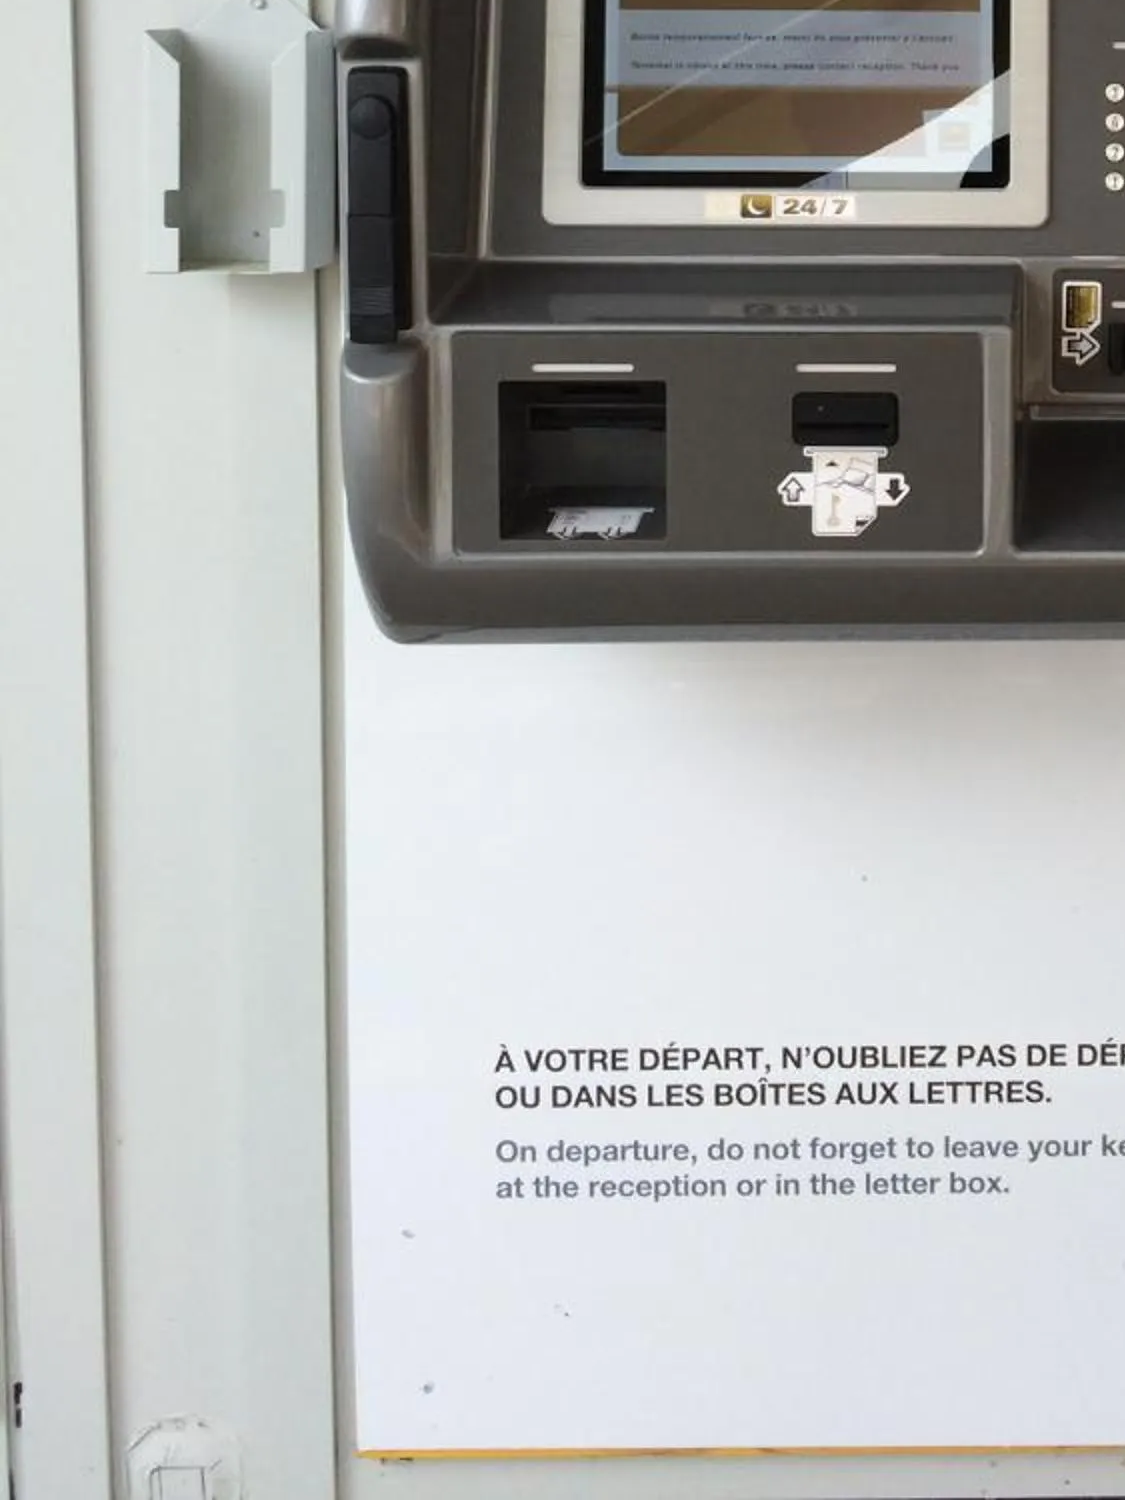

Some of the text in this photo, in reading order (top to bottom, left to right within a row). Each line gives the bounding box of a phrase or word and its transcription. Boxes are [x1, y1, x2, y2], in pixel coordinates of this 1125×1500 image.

[493, 1043, 517, 1074] À
[523, 1047, 630, 1074] VOTRE
[638, 1040, 772, 1075] DÉPART,
[956, 1043, 1018, 1069] PAS
[1025, 1043, 1068, 1068] DE
[494, 1076, 1053, 1110] OU DANS LES BOÎTES AUX LETTRES.
[495, 1139, 538, 1164] On
[545, 1139, 698, 1168] departure,
[706, 1136, 745, 1162] do
[753, 1137, 802, 1161] not
[807, 1136, 898, 1166] forget
[904, 1136, 935, 1160] to
[943, 1134, 1020, 1159] leave
[1026, 1139, 1094, 1164] your
[495, 1171, 1010, 1204] at the reception or in the letter box.
